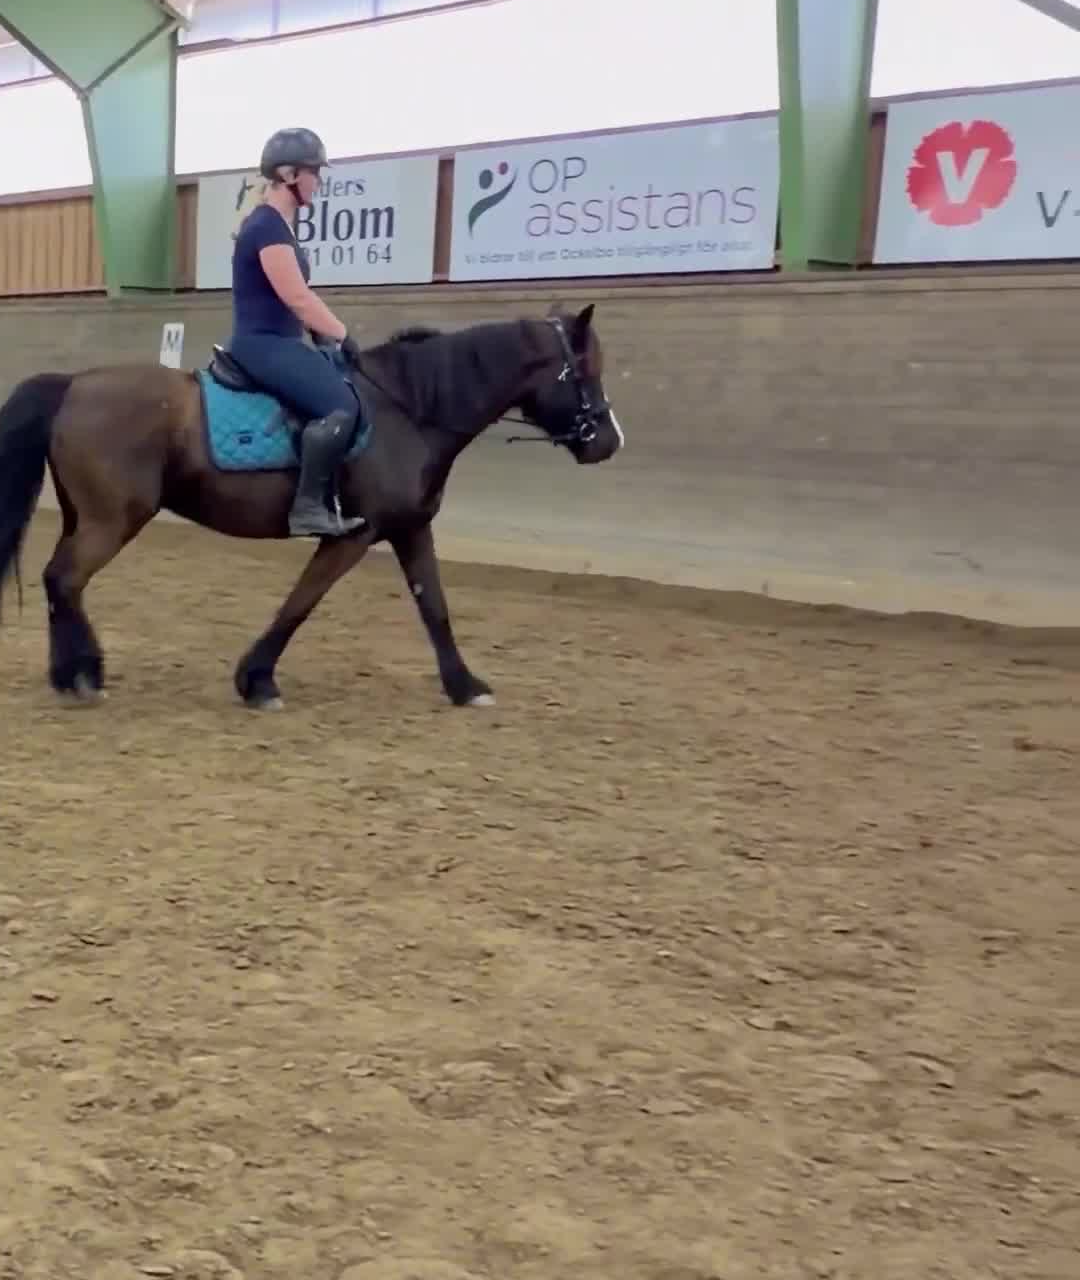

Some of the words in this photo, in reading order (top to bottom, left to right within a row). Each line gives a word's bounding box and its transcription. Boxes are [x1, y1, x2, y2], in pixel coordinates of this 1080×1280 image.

[527, 157, 587, 194] OP
[295, 200, 394, 243] Blom
[525, 183, 758, 238] assistans
[331, 245, 355, 266] 01
[367, 243, 393, 265] 64
